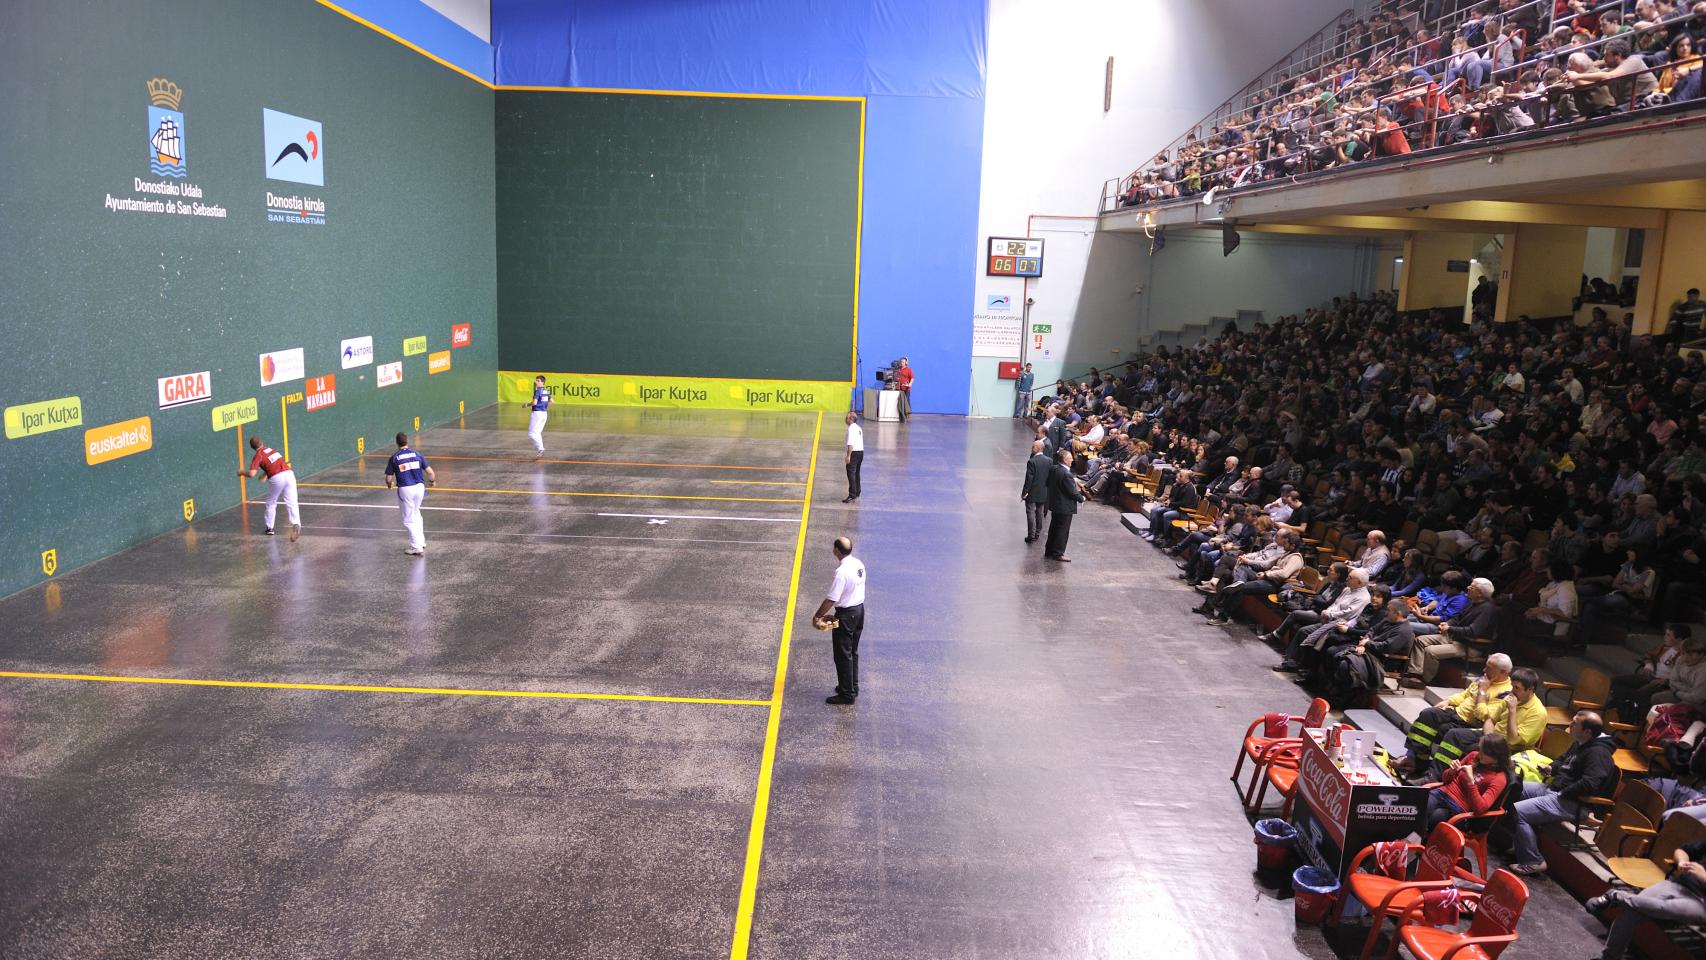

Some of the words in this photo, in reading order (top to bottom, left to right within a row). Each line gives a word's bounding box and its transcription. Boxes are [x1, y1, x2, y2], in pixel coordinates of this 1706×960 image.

[134, 177, 179, 196] Donostiako
[181, 184, 203, 199] Udala
[105, 194, 165, 214] Ayuntamiento
[166, 199, 176, 213] de
[177, 201, 191, 215] San
[193, 203, 227, 218] Sebastian
[266, 192, 303, 210] Donostia
[304, 197, 325, 212] kirola
[268, 214, 284, 223] SAN
[1008, 243, 1025, 255] 22
[994, 259, 1011, 271] 06
[1019, 260, 1036, 272] 07
[164, 373, 205, 402] GARA
[316, 376, 326, 391] LA
[562, 383, 600, 399] Kutxa
[286, 391, 303, 404] FALTA
[306, 390, 336, 410] NAVARRA
[639, 385, 667, 402] Ipar
[669, 386, 707, 403] Kutxa
[746, 388, 773, 405] Ipar
[775, 389, 814, 406] Kutxa
[22, 409, 46, 433] Ipar
[47, 405, 79, 425] Kutxa
[222, 409, 236, 426] Ipar
[237, 405, 256, 421] Kutxa
[89, 430, 139, 456] euskaltel
[185, 501, 193, 517] 5
[45, 552, 54, 572] 6
[1358, 805, 1417, 813] POWERADE
